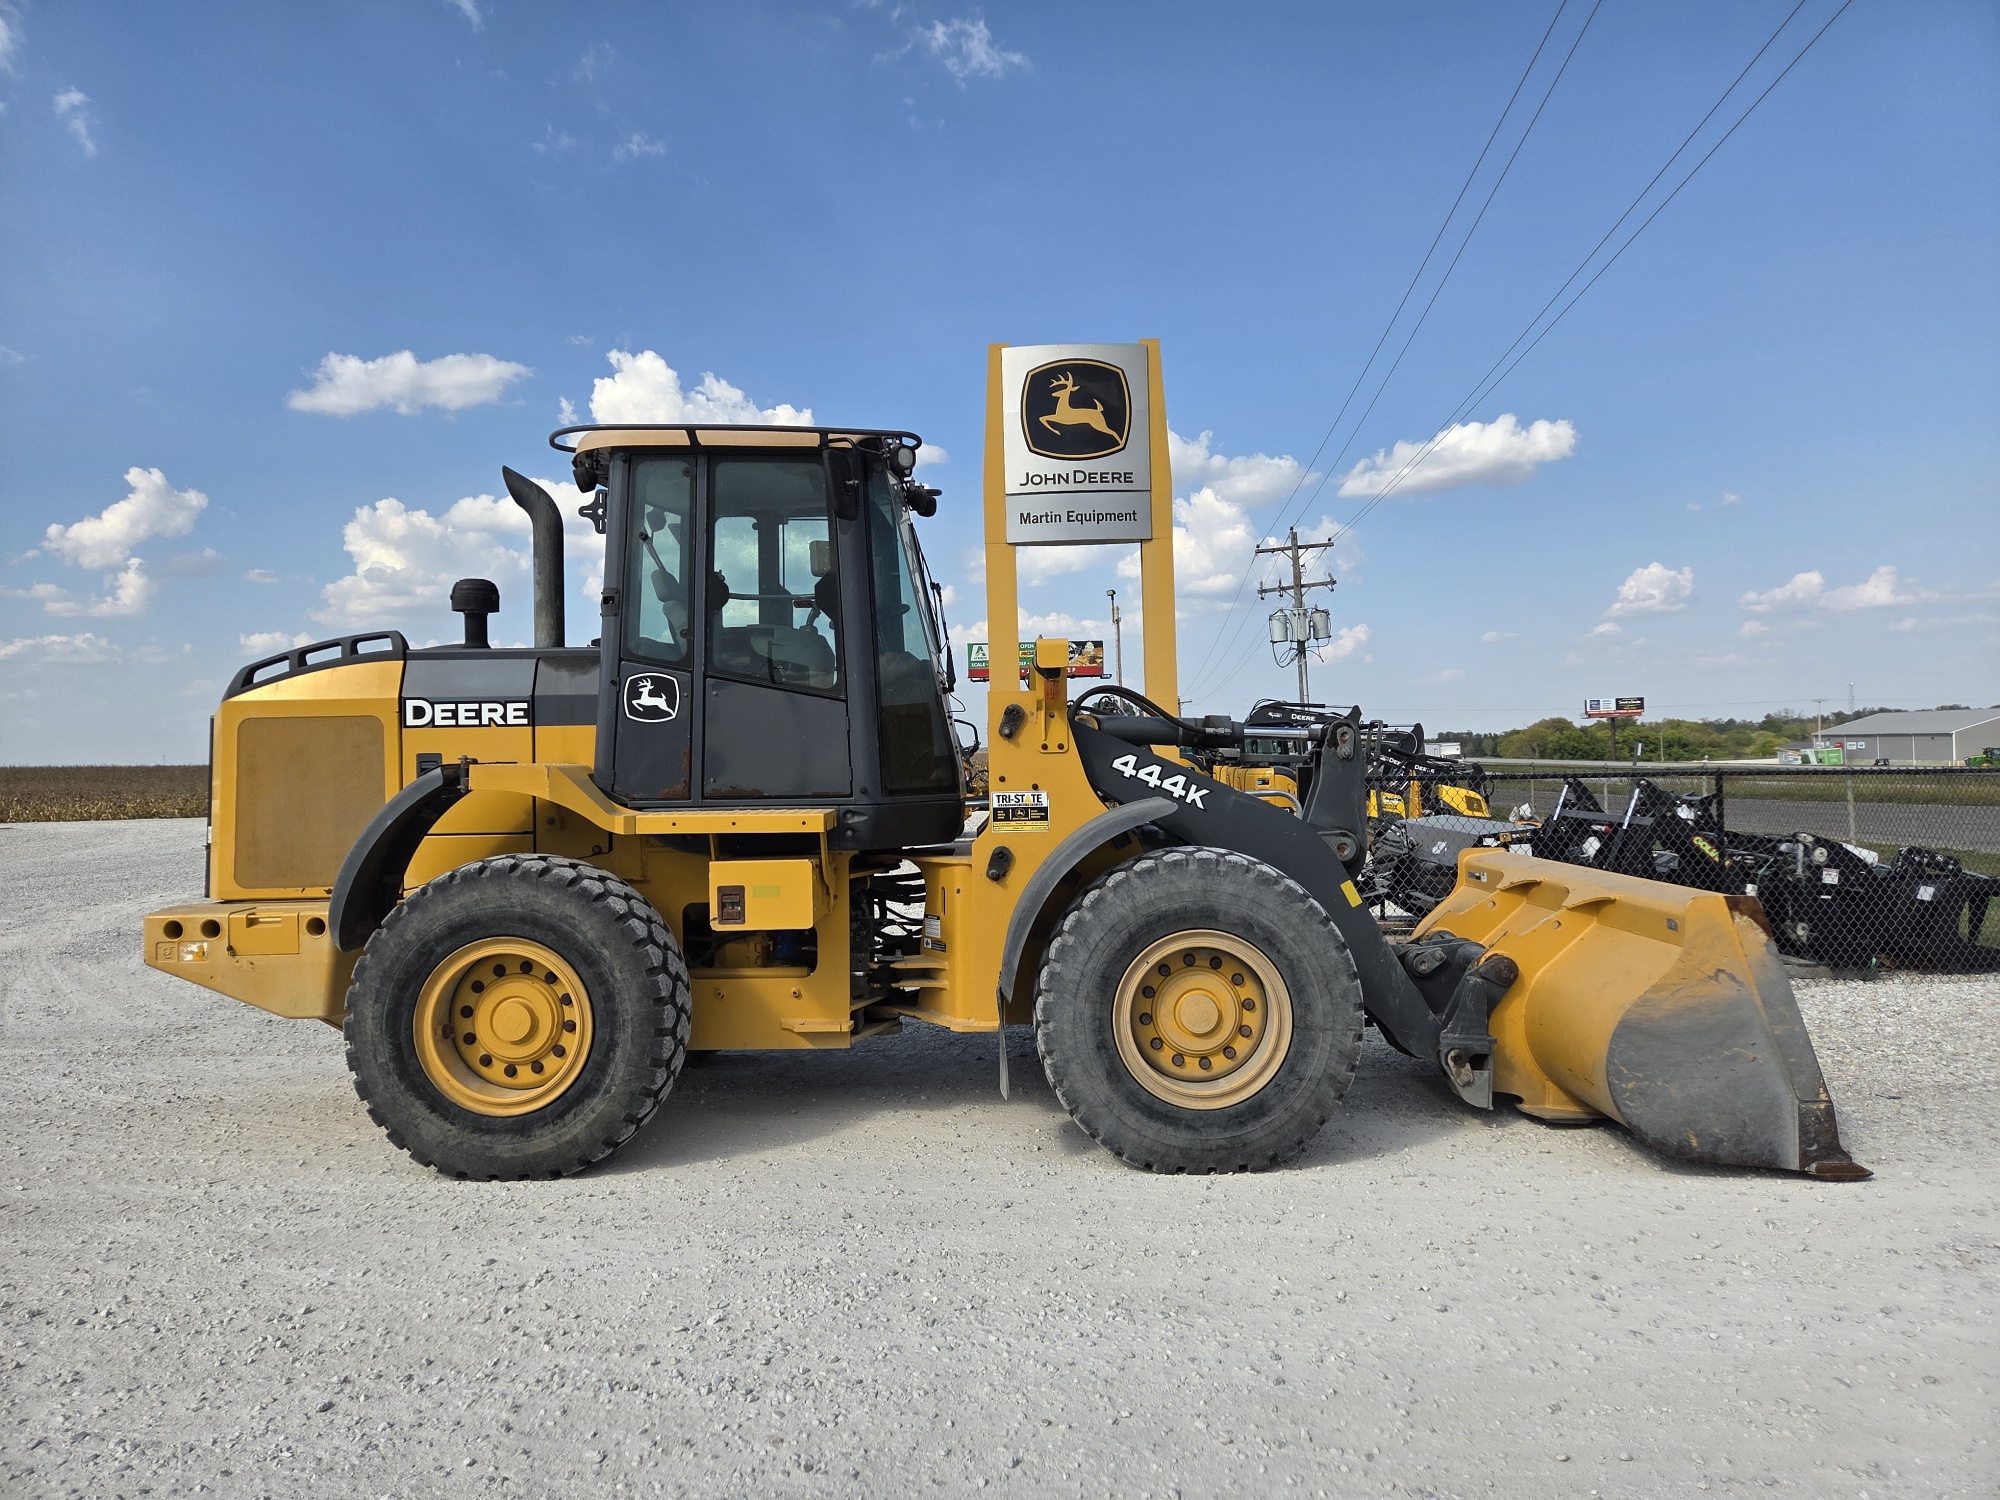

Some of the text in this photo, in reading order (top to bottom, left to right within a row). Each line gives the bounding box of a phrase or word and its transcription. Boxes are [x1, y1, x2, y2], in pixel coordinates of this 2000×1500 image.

[1019, 470, 1134, 486] JOHN DEERE
[1019, 509, 1138, 525] Martin Equipment
[405, 699, 528, 726] DEERE
[1291, 713, 1316, 721] DEERE
[1112, 754, 1210, 810] 444K
[995, 793, 1043, 804] TRI-STATE
